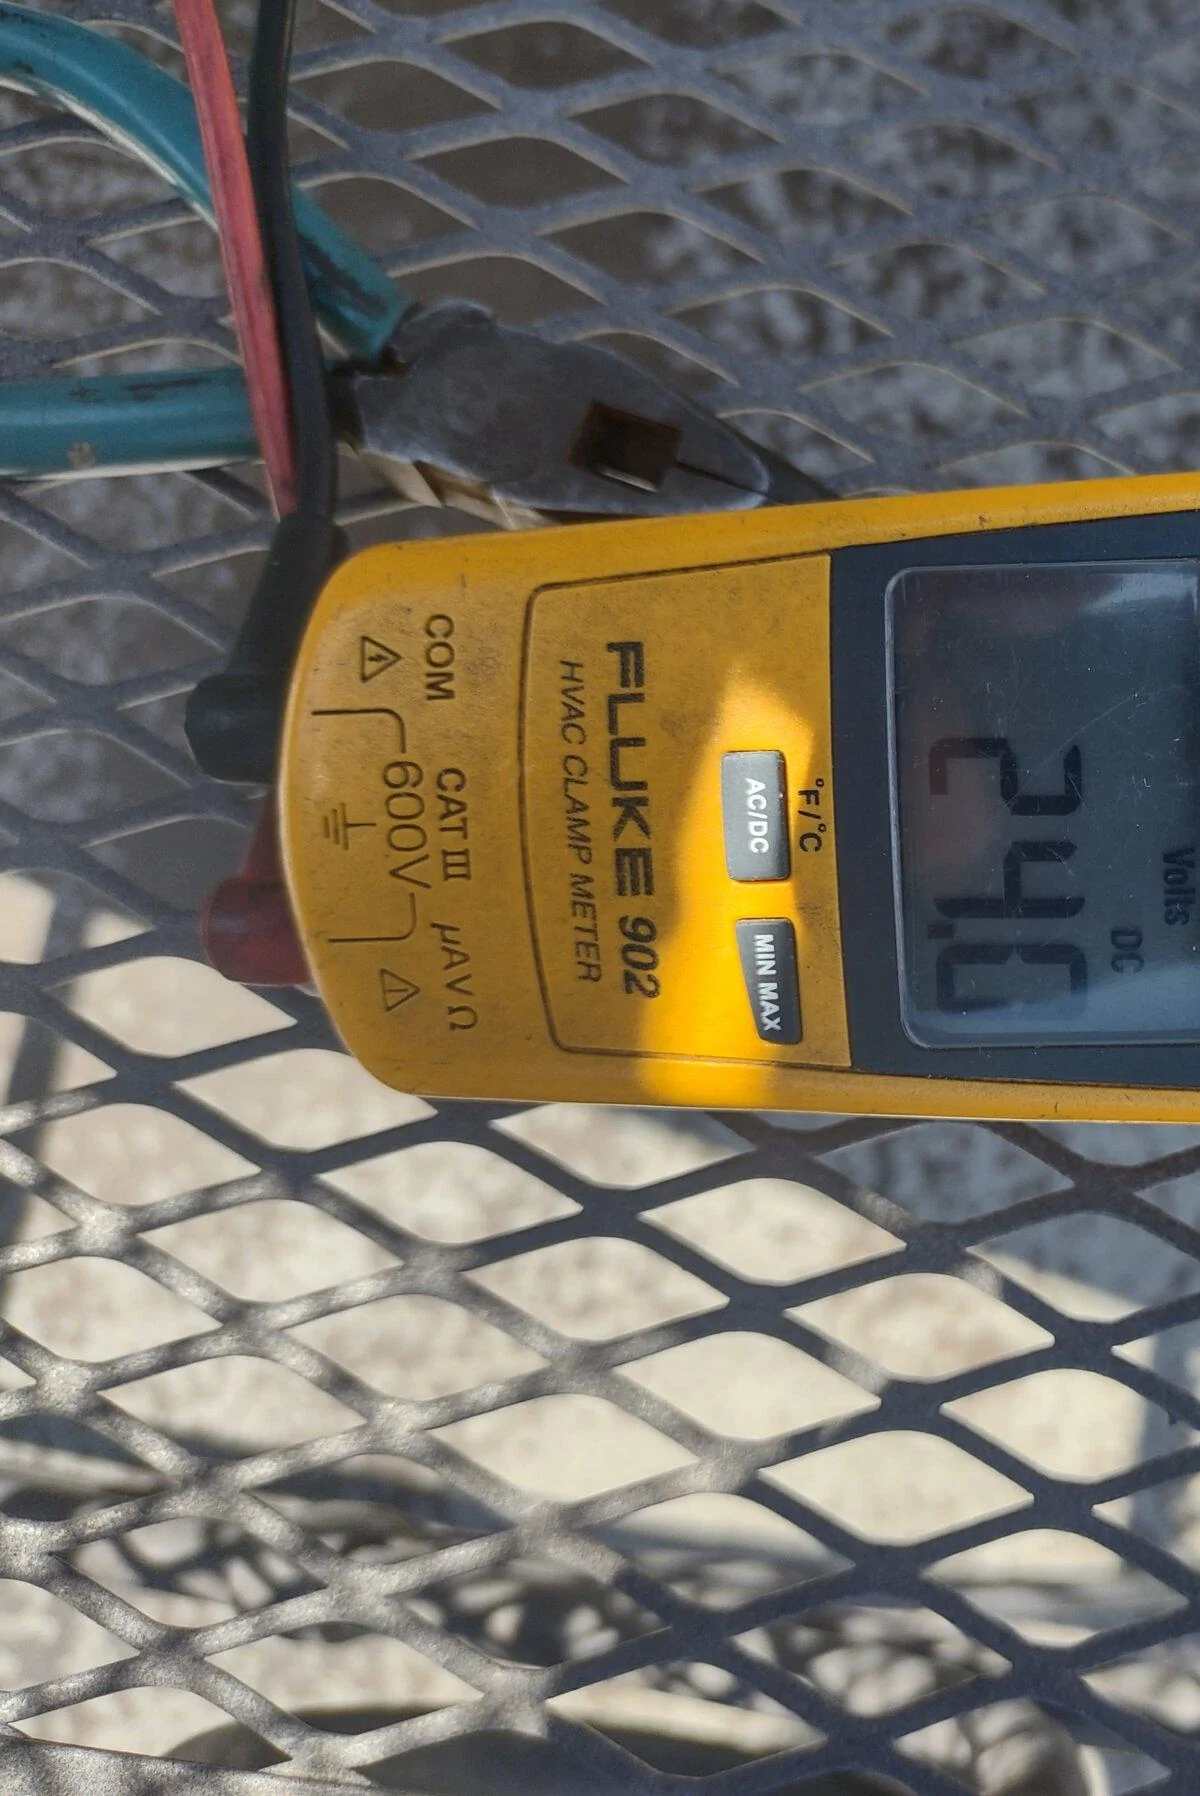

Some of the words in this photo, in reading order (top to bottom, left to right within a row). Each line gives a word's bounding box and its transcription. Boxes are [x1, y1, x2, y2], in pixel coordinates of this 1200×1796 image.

[424, 613, 455, 700] COM
[559, 659, 587, 746] HVAC
[436, 767, 469, 840] CAT
[562, 754, 593, 864] CLAMP
[606, 641, 655, 896] FLUKE
[382, 760, 432, 889] 600V
[744, 776, 770, 854] AC/DC
[441, 849, 472, 881] III
[927, 737, 1089, 1019] 24.0
[1161, 846, 1197, 926] Volts
[569, 873, 601, 983] METER
[619, 915, 661, 999] 902
[752, 933, 777, 976] MIN
[1110, 928, 1145, 975] DC
[757, 982, 781, 1031] MAX
